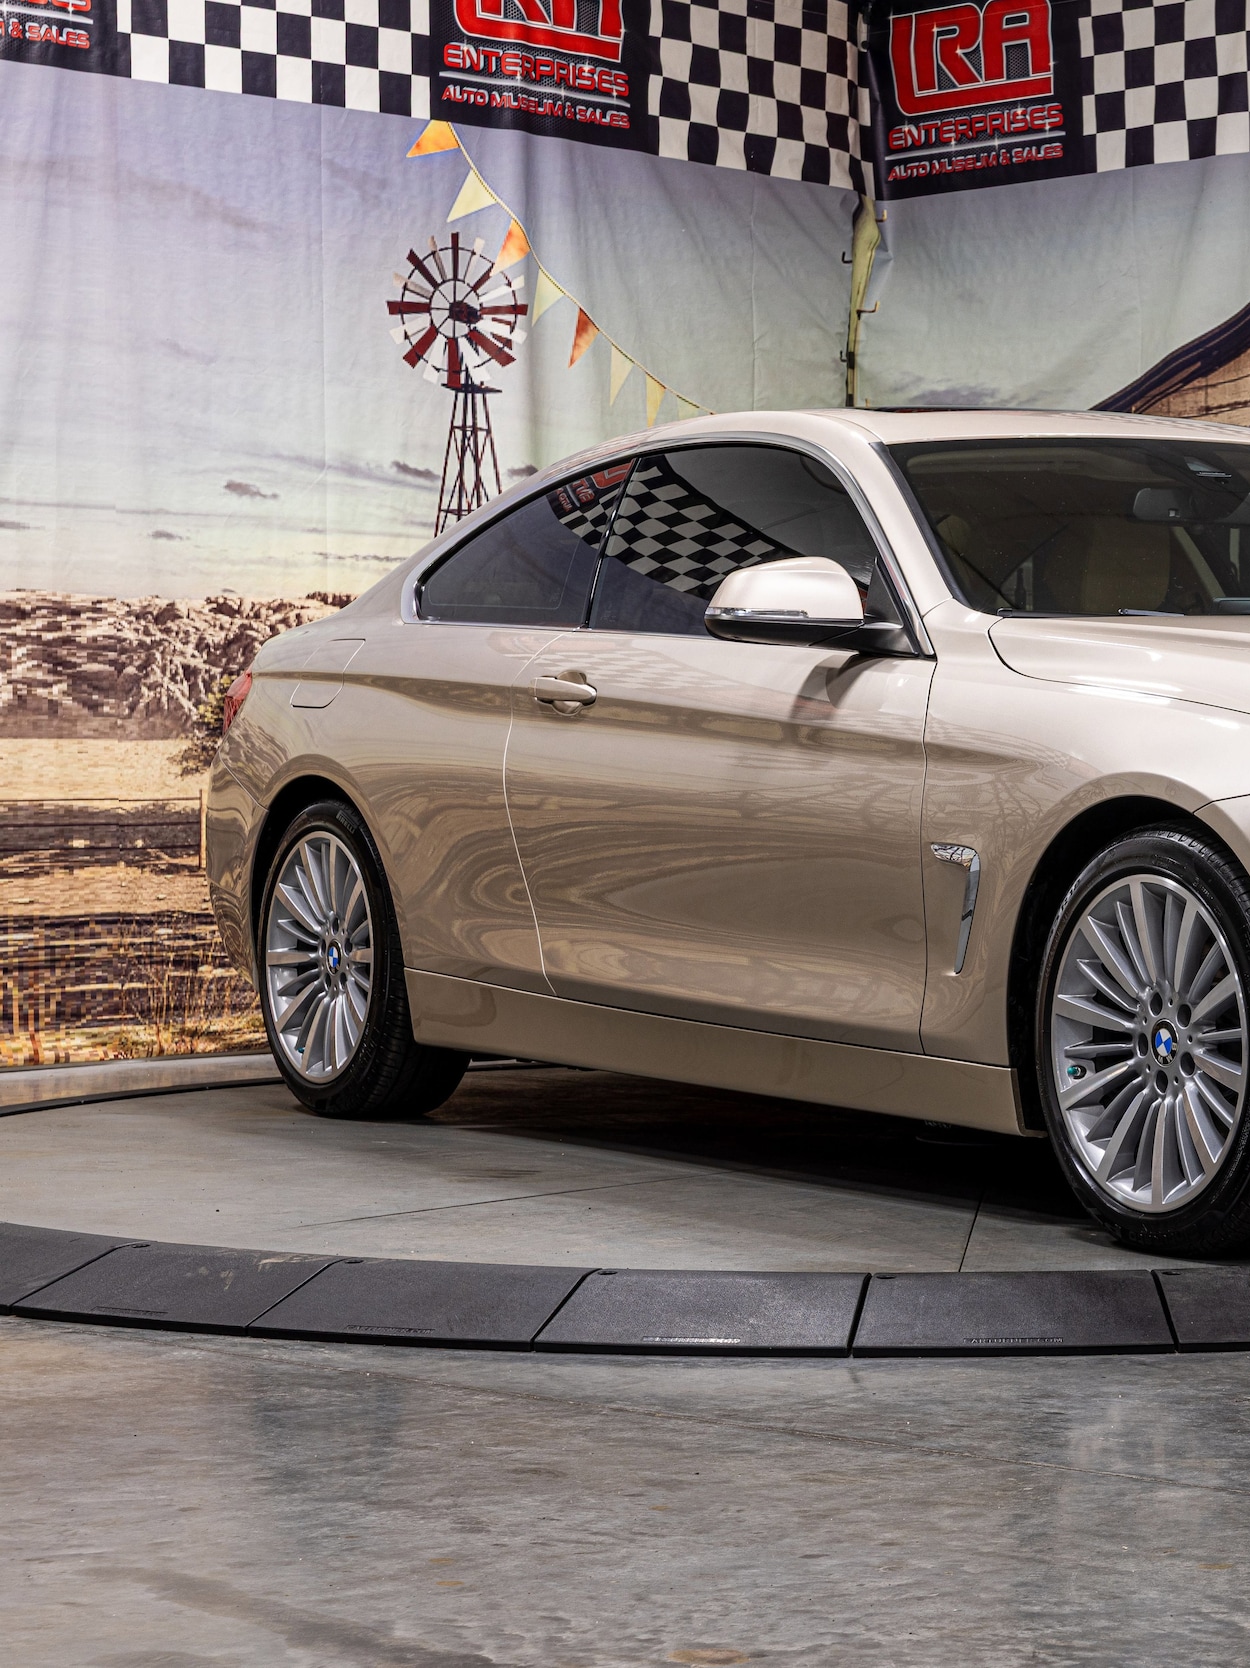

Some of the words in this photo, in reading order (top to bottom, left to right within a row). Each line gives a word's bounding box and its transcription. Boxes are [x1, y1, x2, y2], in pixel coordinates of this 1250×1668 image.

[9, 18, 23, 39] &
[25, 22, 91, 49] SALES
[443, 41, 630, 97] ENTERPRISES
[441, 84, 489, 107] AUTO
[490, 91, 564, 118] MUSEUM
[564, 102, 575, 120] &
[576, 106, 631, 129] SALES
[888, 103, 1064, 149] ENTERPRISES
[888, 161, 930, 181] AUTO
[931, 151, 999, 174] MUSEUM
[999, 149, 1011, 166] &
[1012, 142, 1064, 164] SALES
